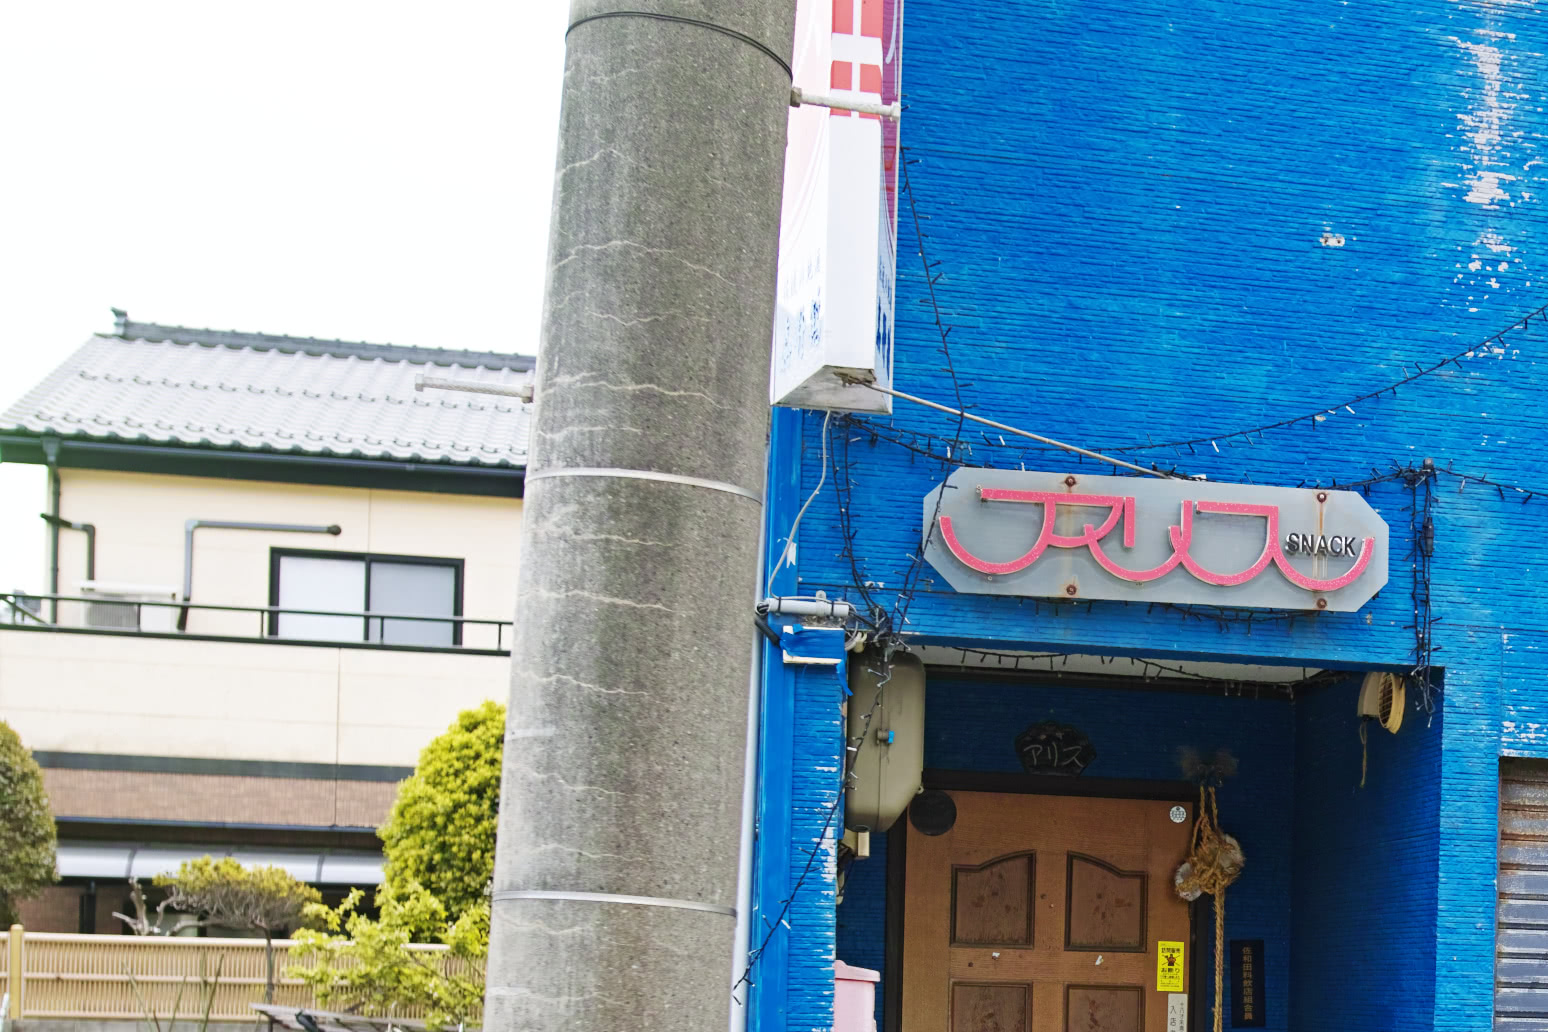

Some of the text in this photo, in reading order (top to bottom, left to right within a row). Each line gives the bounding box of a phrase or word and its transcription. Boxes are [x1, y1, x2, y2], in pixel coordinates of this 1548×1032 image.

[1285, 532, 1356, 557] SNACK
[1023, 741, 1085, 769] アリス
